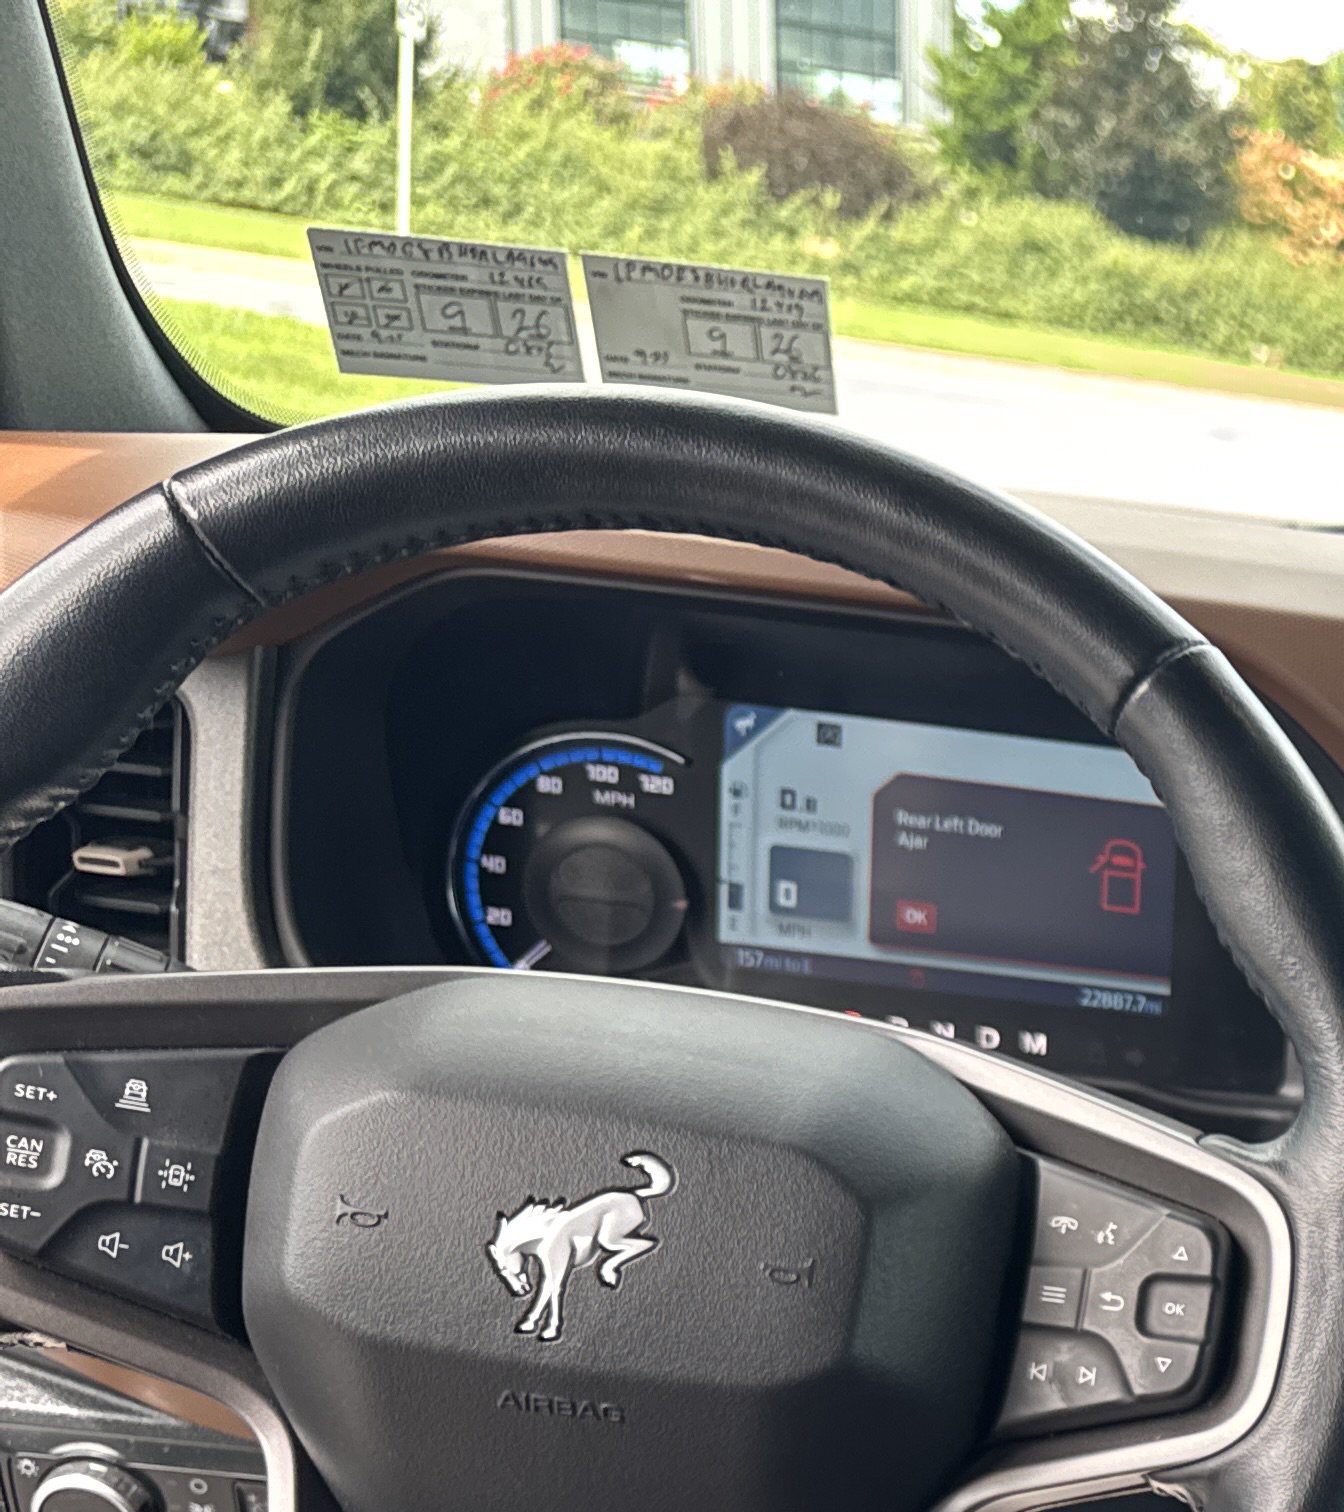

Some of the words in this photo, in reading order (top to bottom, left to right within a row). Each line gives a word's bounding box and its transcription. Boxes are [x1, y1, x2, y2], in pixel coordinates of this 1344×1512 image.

[586, 764, 620, 784] 100
[639, 773, 675, 795] 120
[536, 775, 563, 795] 80
[592, 789, 635, 809] MPH
[498, 806, 524, 827] 60
[897, 809, 931, 829] Rear
[934, 813, 964, 834] Left
[968, 820, 1003, 837] Door
[897, 832, 928, 850] Ajar
[481, 854, 507, 875] 40
[486, 906, 512, 927] 20
[903, 907, 928, 925] OK
[975, 1025, 1001, 1050] D
[1018, 1030, 1048, 1056] M
[14, 1083, 58, 1101] SET+
[6, 1134, 44, 1153] CAN
[6, 1152, 39, 1169] RES
[1164, 1302, 1185, 1316] OK
[497, 1389, 626, 1424] AIRBAG
